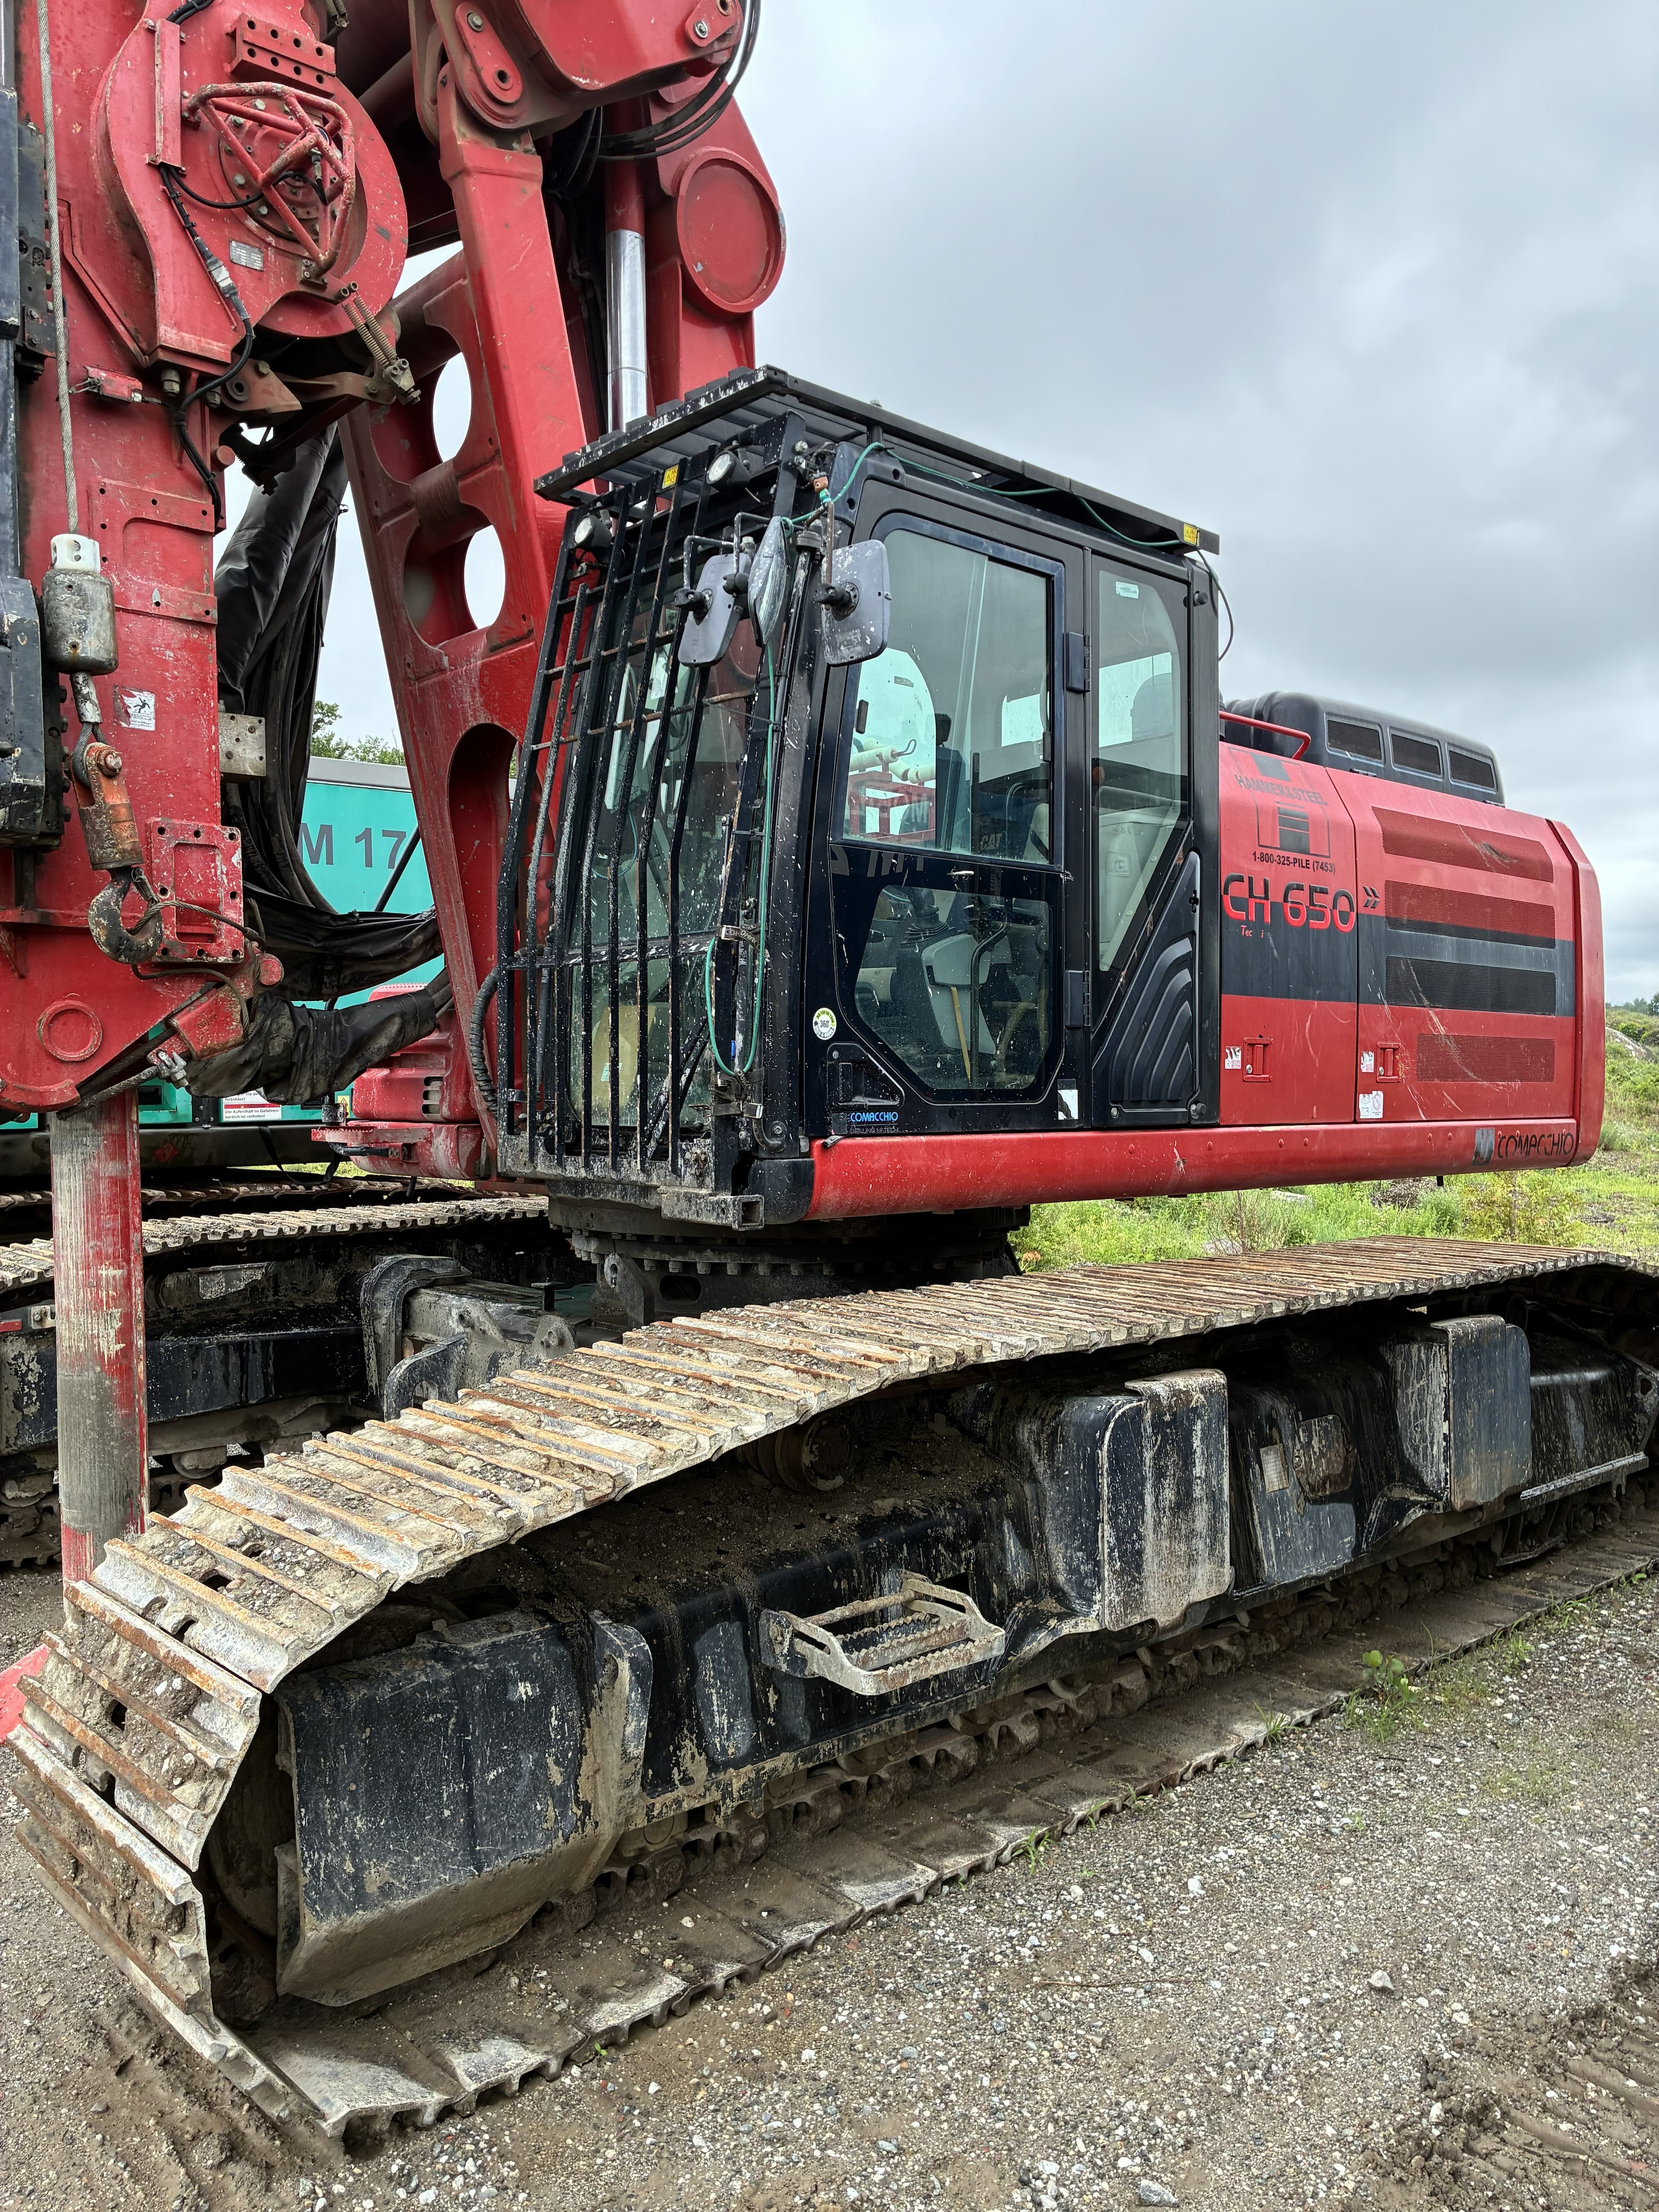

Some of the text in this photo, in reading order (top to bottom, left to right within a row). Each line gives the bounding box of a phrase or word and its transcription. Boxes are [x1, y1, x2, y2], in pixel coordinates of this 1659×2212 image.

[355, 827, 407, 869] 17
[979, 833, 1003, 851] CAT
[1252, 851, 1335, 875] 1-800-325-PILE (7453)
[1223, 873, 1356, 933] CH 650
[850, 1112, 898, 1122] COMACCHIO
[1497, 1132, 1574, 1159] COMACCHIO
